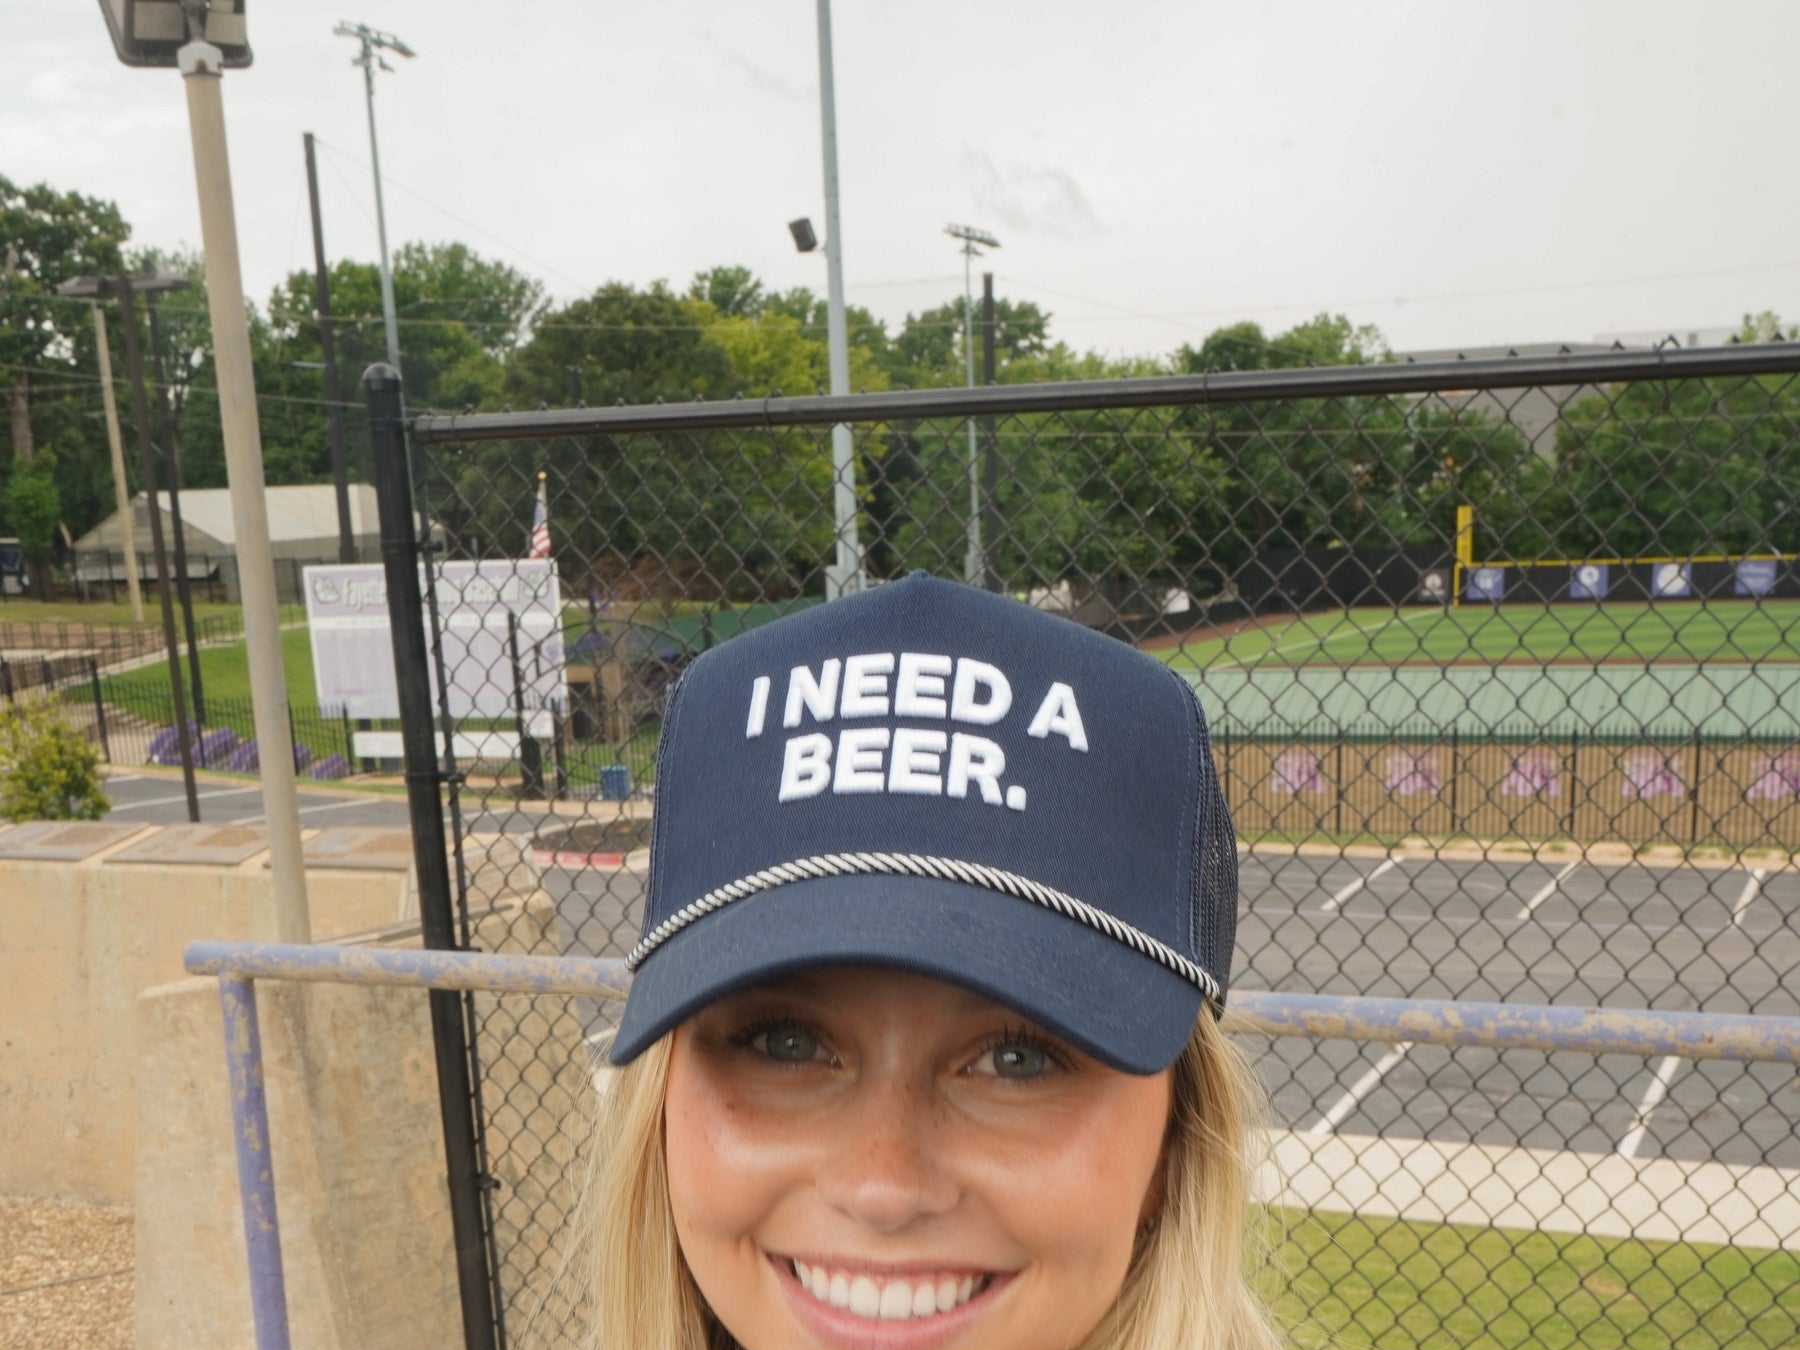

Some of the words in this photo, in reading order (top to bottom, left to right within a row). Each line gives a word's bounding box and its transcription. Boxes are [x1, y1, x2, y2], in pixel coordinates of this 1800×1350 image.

[746, 676, 771, 739] I
[783, 652, 1012, 728] NEED
[1027, 681, 1089, 753] A
[778, 727, 1027, 811] BEER.
